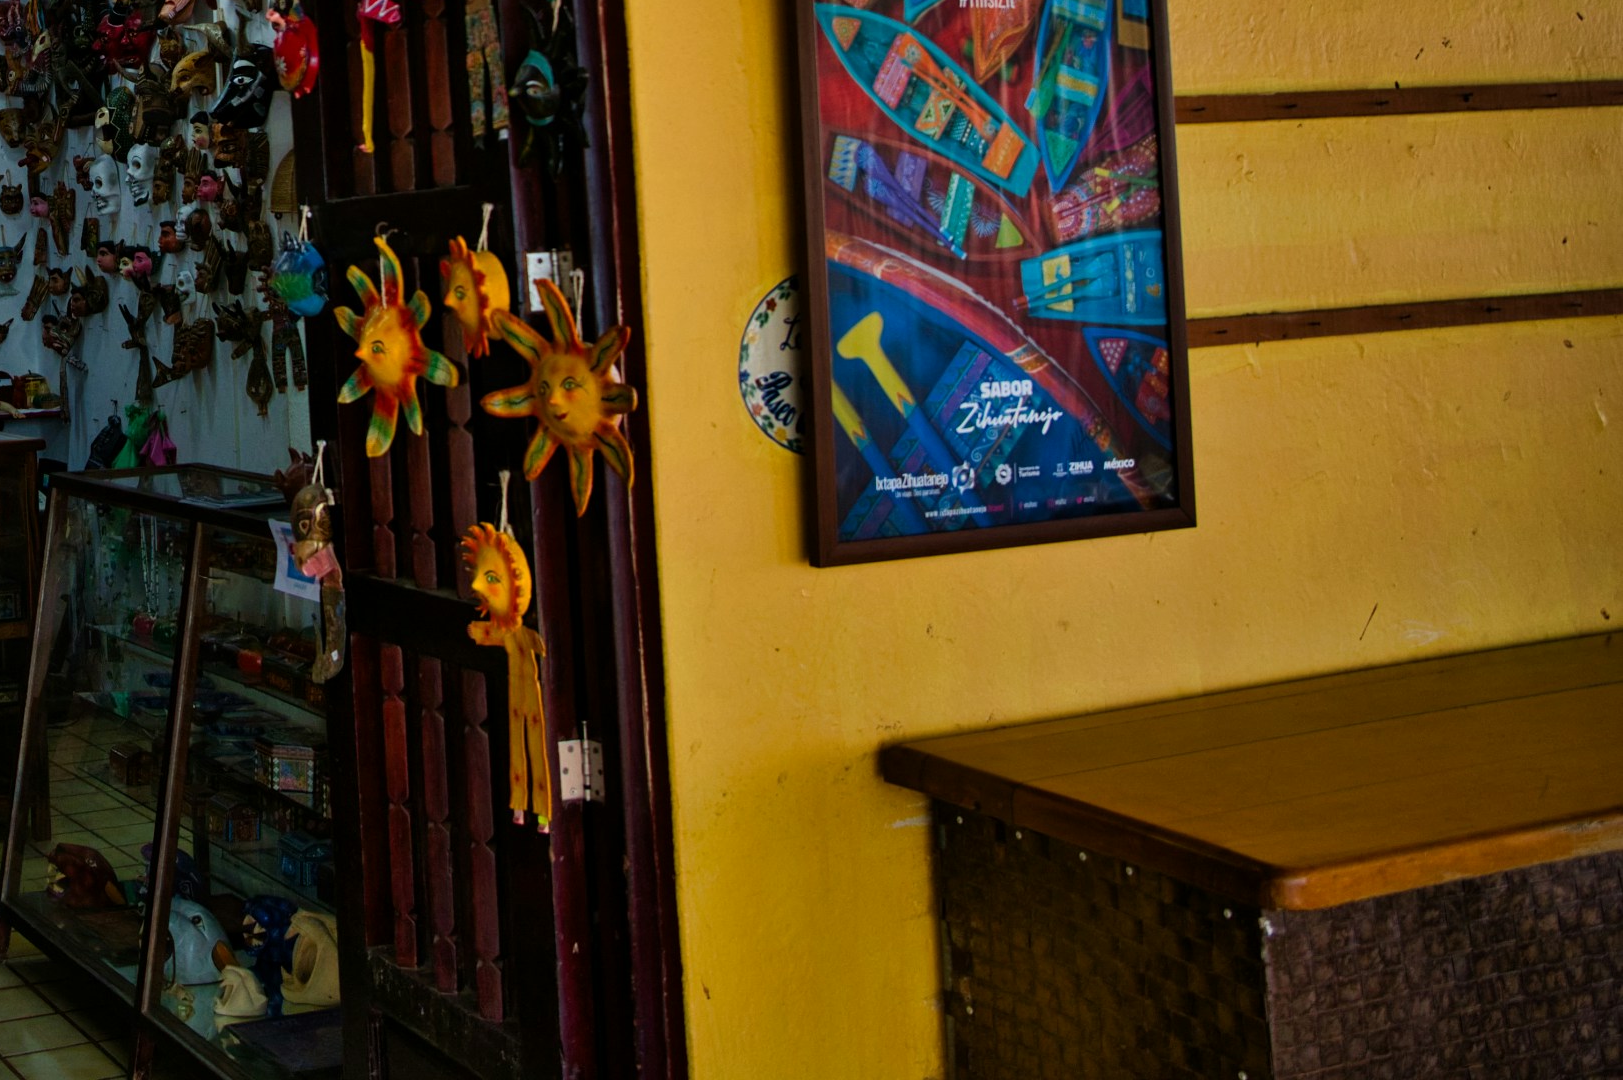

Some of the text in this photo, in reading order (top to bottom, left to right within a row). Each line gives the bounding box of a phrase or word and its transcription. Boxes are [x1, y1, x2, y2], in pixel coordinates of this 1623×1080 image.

[755, 371, 797, 427] Paseo
[980, 379, 1033, 399] SABOR
[956, 396, 1064, 435] Zihuatanejo
[1068, 460, 1094, 472] ZIHUA
